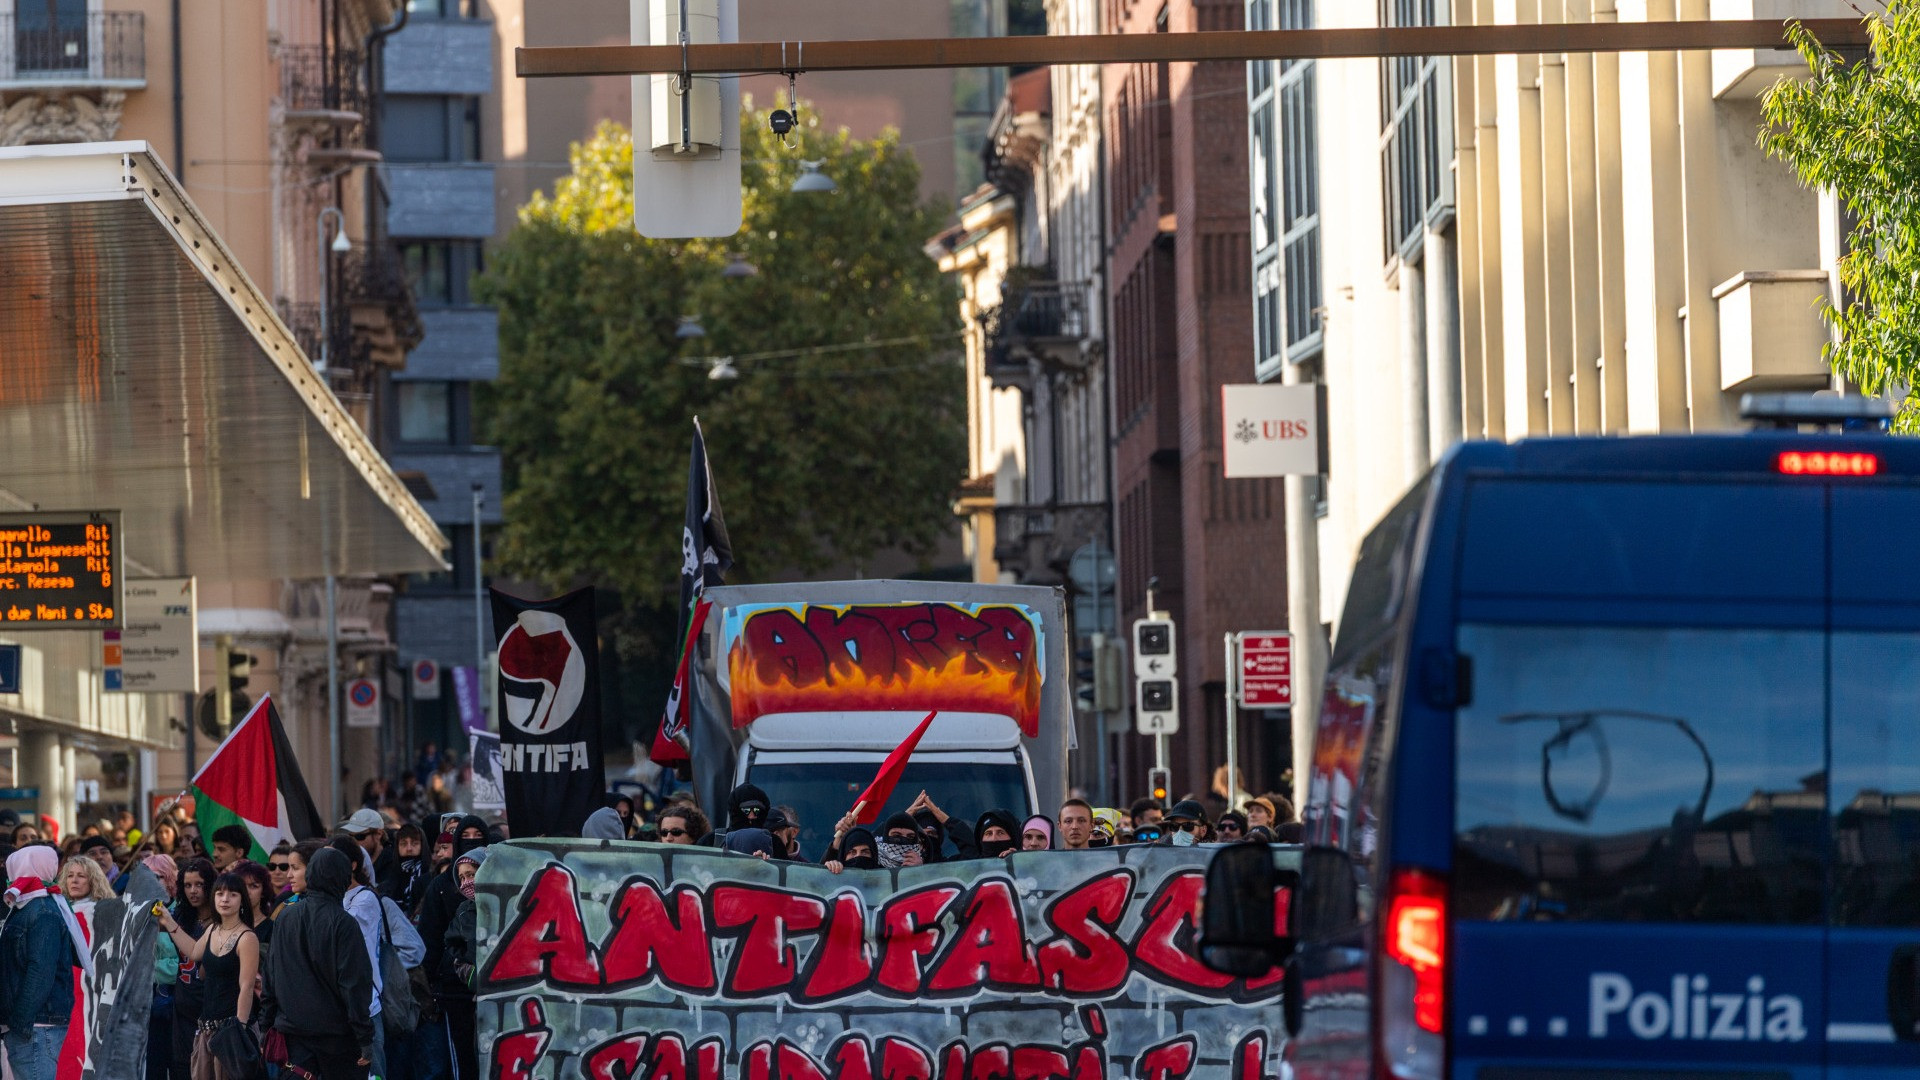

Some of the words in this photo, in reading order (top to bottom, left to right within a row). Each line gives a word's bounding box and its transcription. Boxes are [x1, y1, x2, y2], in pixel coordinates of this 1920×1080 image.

[1263, 419, 1308, 440] UBS
[86, 524, 110, 541] Rit
[86, 541, 110, 557] Rit
[87, 557, 110, 572] Rit
[8, 605, 32, 620] due
[37, 604, 67, 620] Mani
[74, 608, 84, 620] a
[89, 603, 113, 619] Sta
[743, 603, 1038, 691] ANTIFA
[500, 741, 589, 773] ANTIFA
[476, 860, 1297, 1004] ANTIFASC
[1589, 972, 1806, 1041] Polizia
